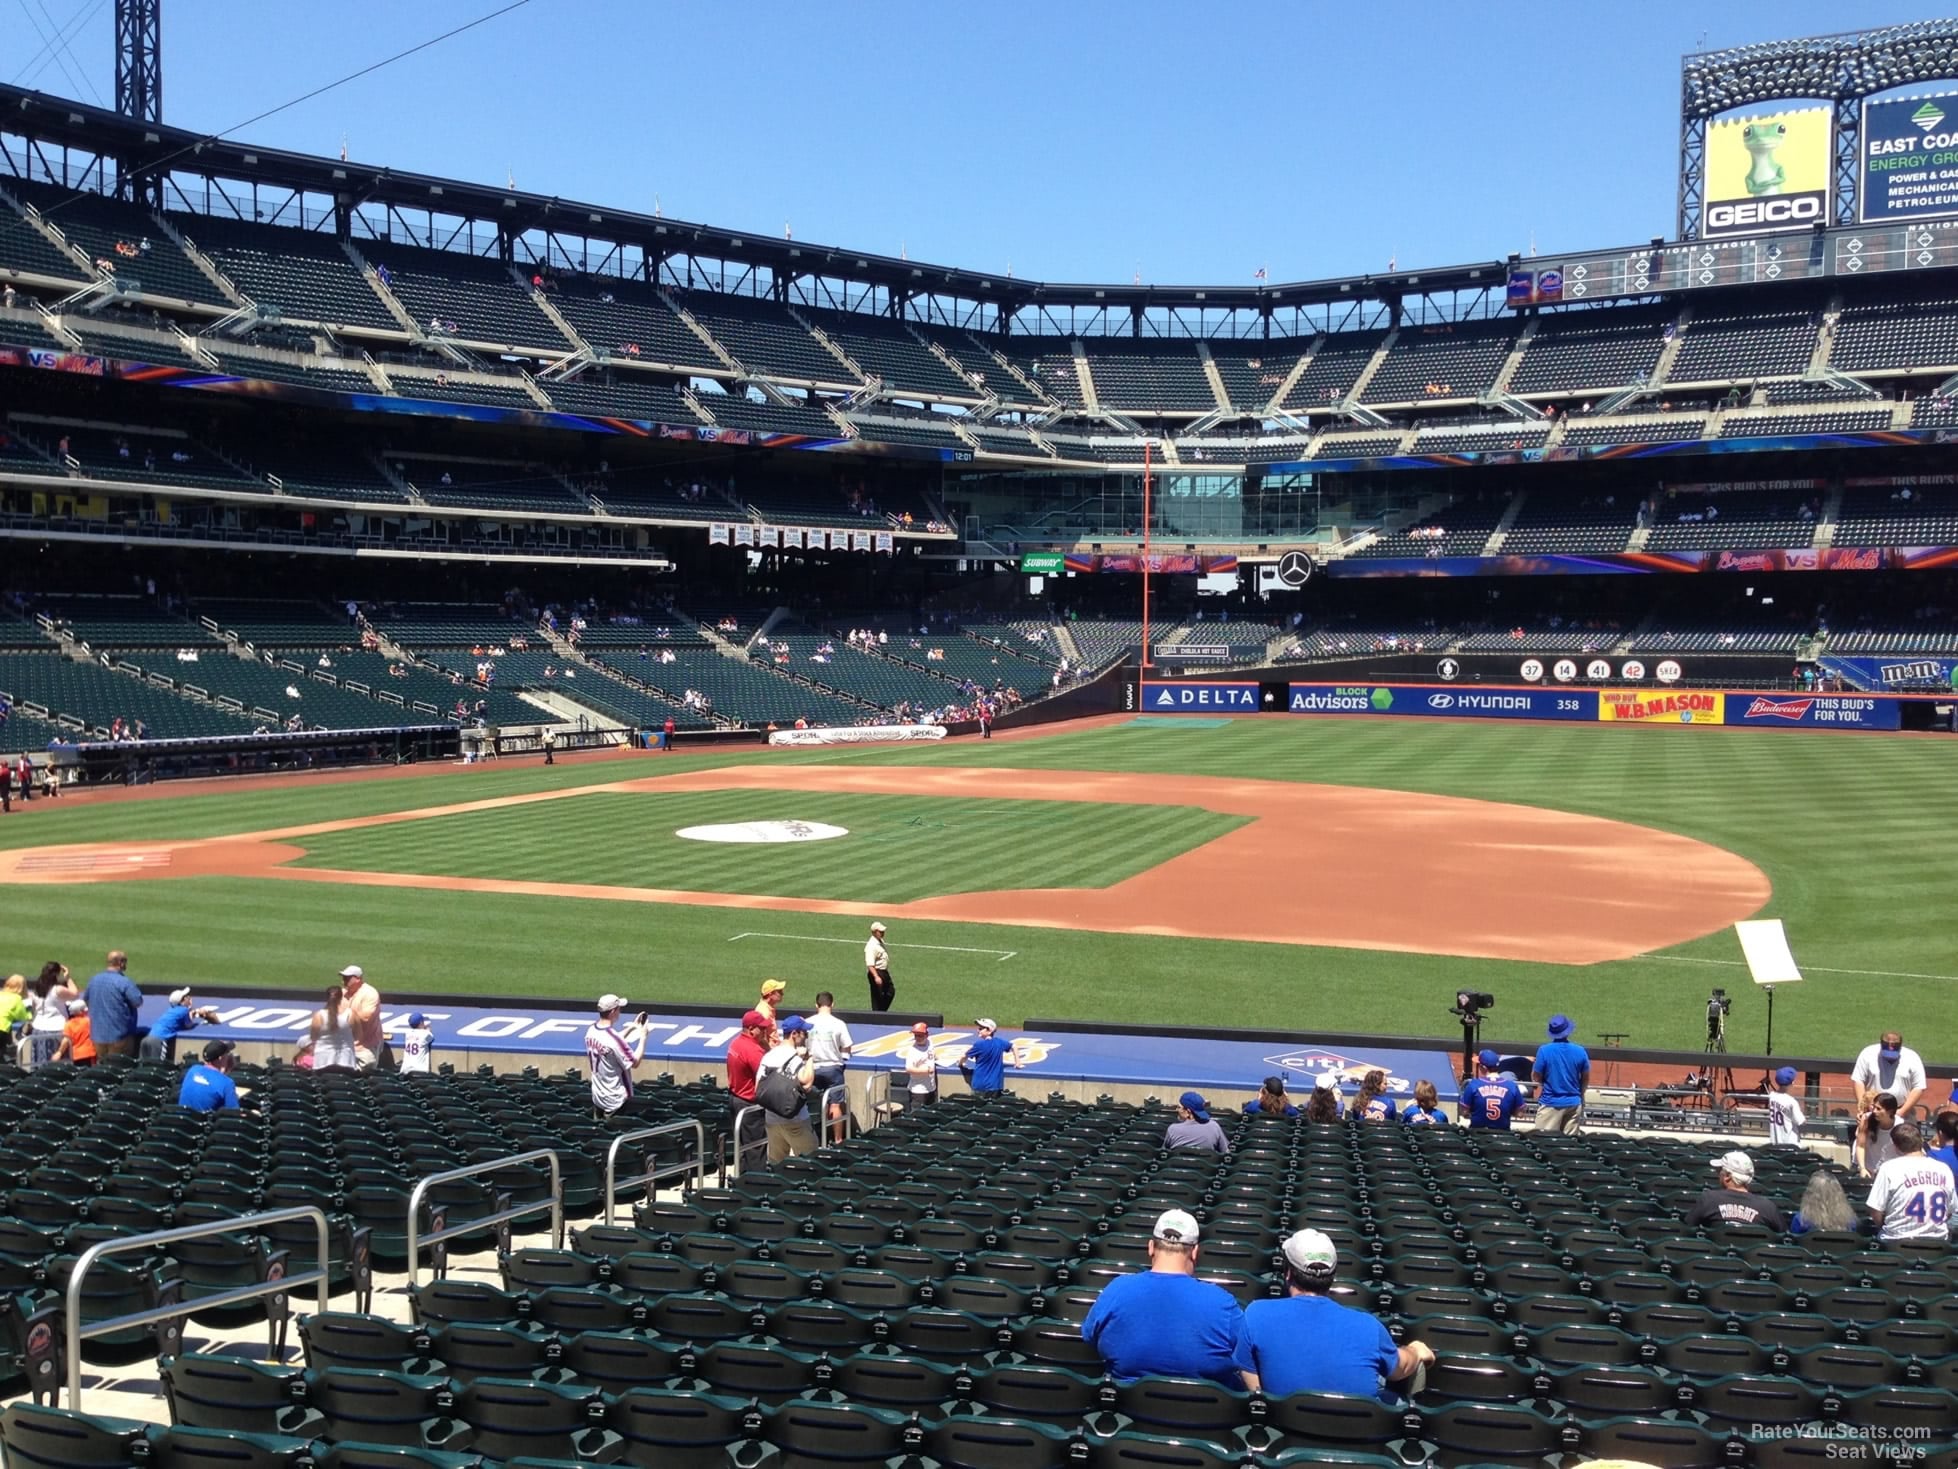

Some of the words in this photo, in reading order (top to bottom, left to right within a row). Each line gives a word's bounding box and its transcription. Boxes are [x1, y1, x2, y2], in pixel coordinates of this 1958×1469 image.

[1869, 137, 1918, 155] EAST
[1869, 155, 1928, 172] ENERGY
[1888, 172, 1927, 184] POWER
[1929, 171, 1937, 180] &
[1708, 197, 1820, 228] GEICO
[1705, 240, 1757, 251] LEAGUE
[29, 352, 57, 368] VS
[698, 430, 717, 440] VS
[1523, 452, 1543, 461] VS
[1769, 480, 1790, 489] FOR
[1892, 477, 1916, 485] THIS
[1024, 559, 1060, 567] SUBWAY
[1785, 555, 1817, 567] VS
[1525, 665, 1539, 676] 37
[1560, 665, 1570, 675] 14
[1593, 666, 1605, 676] 41
[1626, 666, 1640, 676] 42
[1181, 690, 1254, 704] DELTA
[1335, 687, 1368, 696] BLOCK
[1291, 693, 1368, 709] Advisors
[1458, 695, 1531, 710] HYUNDAI
[1557, 699, 1579, 710] 358
[1647, 694, 1715, 716] MASON
[1815, 699, 1839, 709] THIS
[1841, 699, 1874, 710] BUD'S
[1751, 702, 1807, 713] Budweiser
[1815, 710, 1837, 721] FOR
[1838, 711, 1862, 721] YOU.
[457, 1016, 597, 1039] OF
[617, 1022, 746, 1048] TH
[405, 1042, 419, 1055] 48
[589, 1050, 601, 1072] 17
[1282, 1056, 1345, 1069] citi
[1486, 1098, 1502, 1121] 5
[1904, 1191, 1948, 1225] 48
